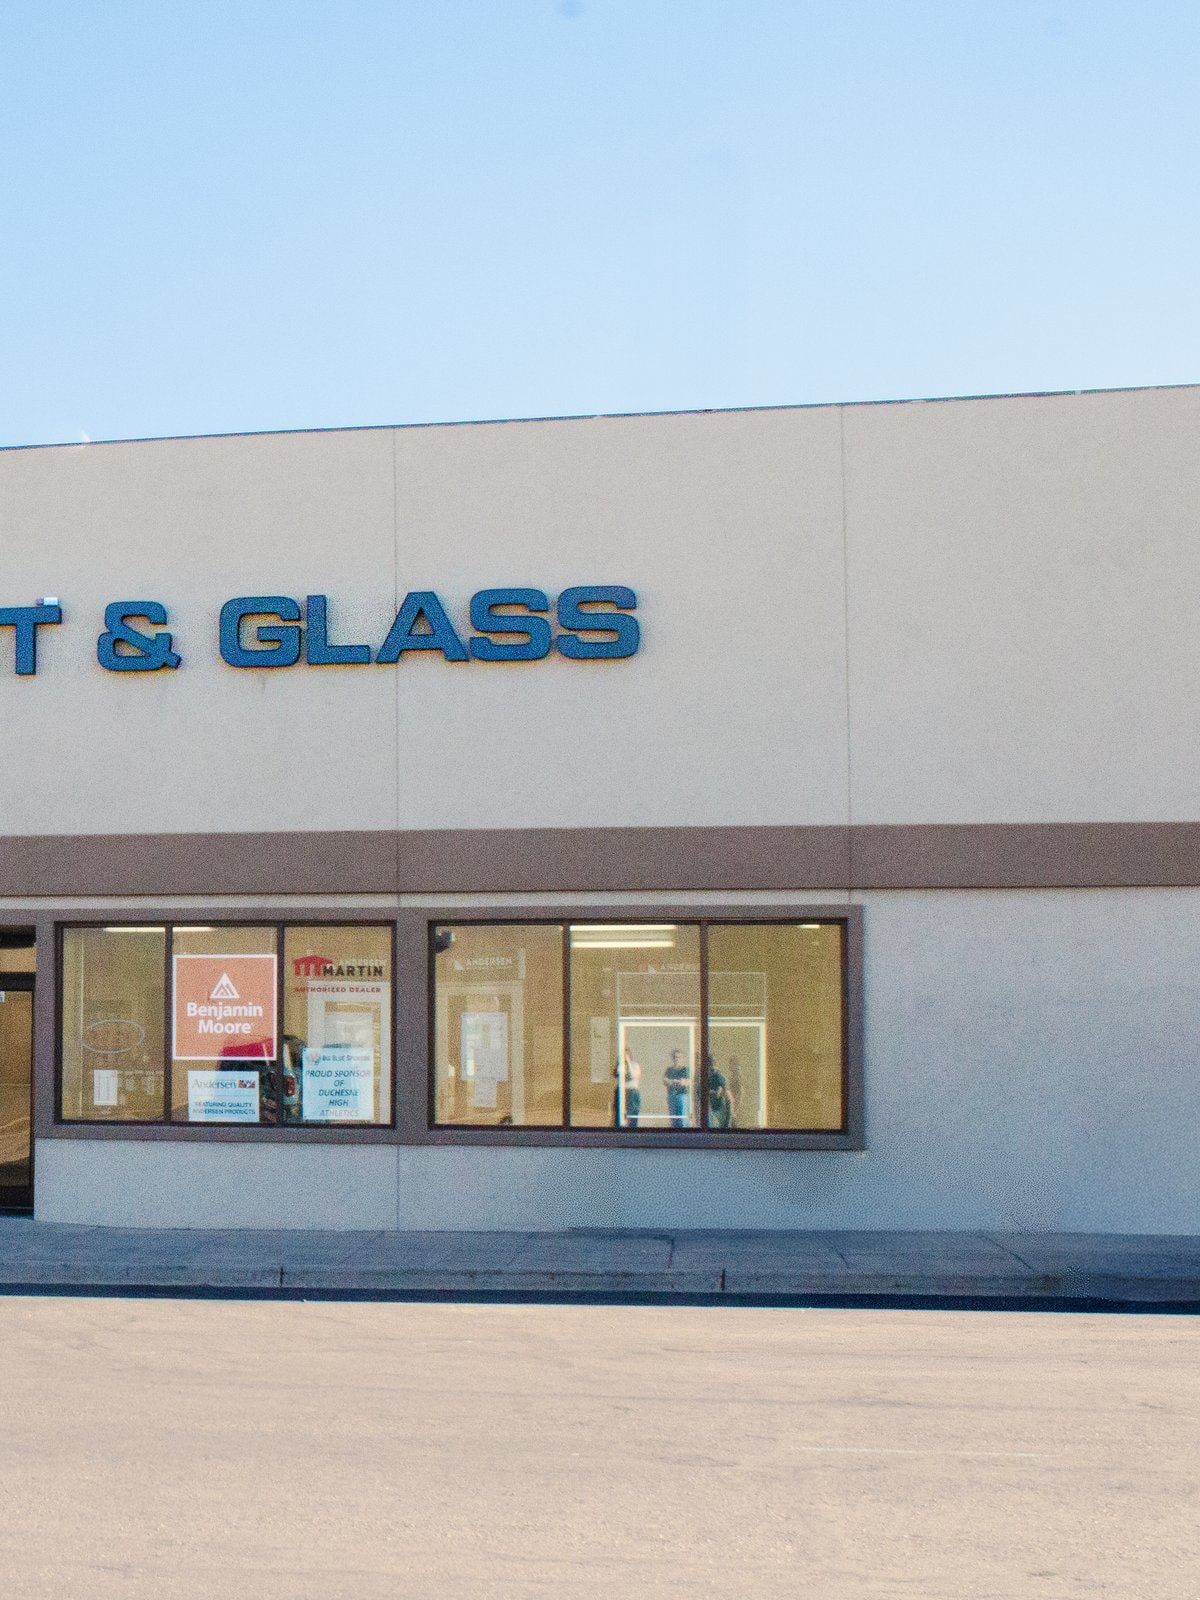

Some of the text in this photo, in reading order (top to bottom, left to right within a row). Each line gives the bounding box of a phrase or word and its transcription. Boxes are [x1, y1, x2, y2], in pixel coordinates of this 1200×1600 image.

[97, 600, 182, 673] &
[218, 585, 641, 668] GLASS
[322, 965, 384, 977] MARTIN
[186, 1002, 264, 1020] Benjamin
[197, 1019, 252, 1034] Moore
[305, 1070, 333, 1078] PROUD
[192, 1079, 237, 1089] Andersen
[318, 1089, 359, 1097] DUCHESNE
[328, 1099, 349, 1107] HIGH
[320, 1109, 360, 1117] ATHLETICS
